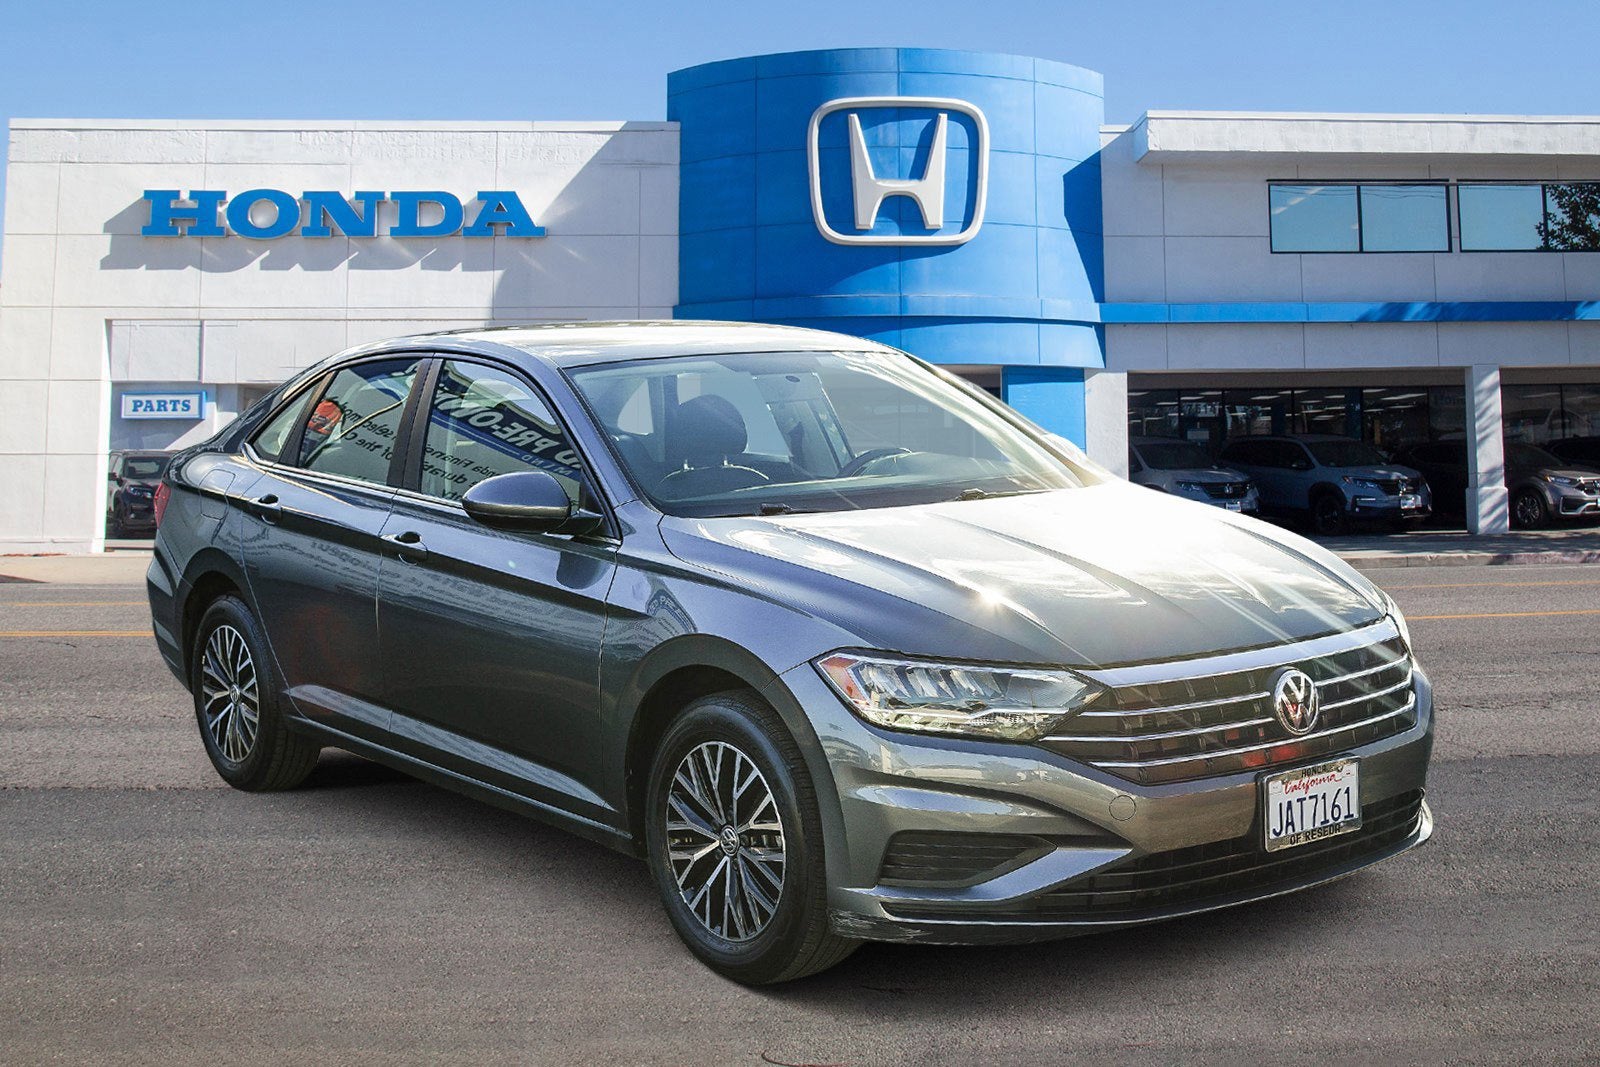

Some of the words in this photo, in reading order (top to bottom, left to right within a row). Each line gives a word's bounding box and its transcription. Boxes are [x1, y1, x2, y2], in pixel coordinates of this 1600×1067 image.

[141, 189, 547, 239] HONDA
[131, 399, 192, 413] PARTS
[1272, 786, 1354, 836] JAT7161
[1290, 834, 1301, 845] OF
[1305, 823, 1341, 841] RESEDA
